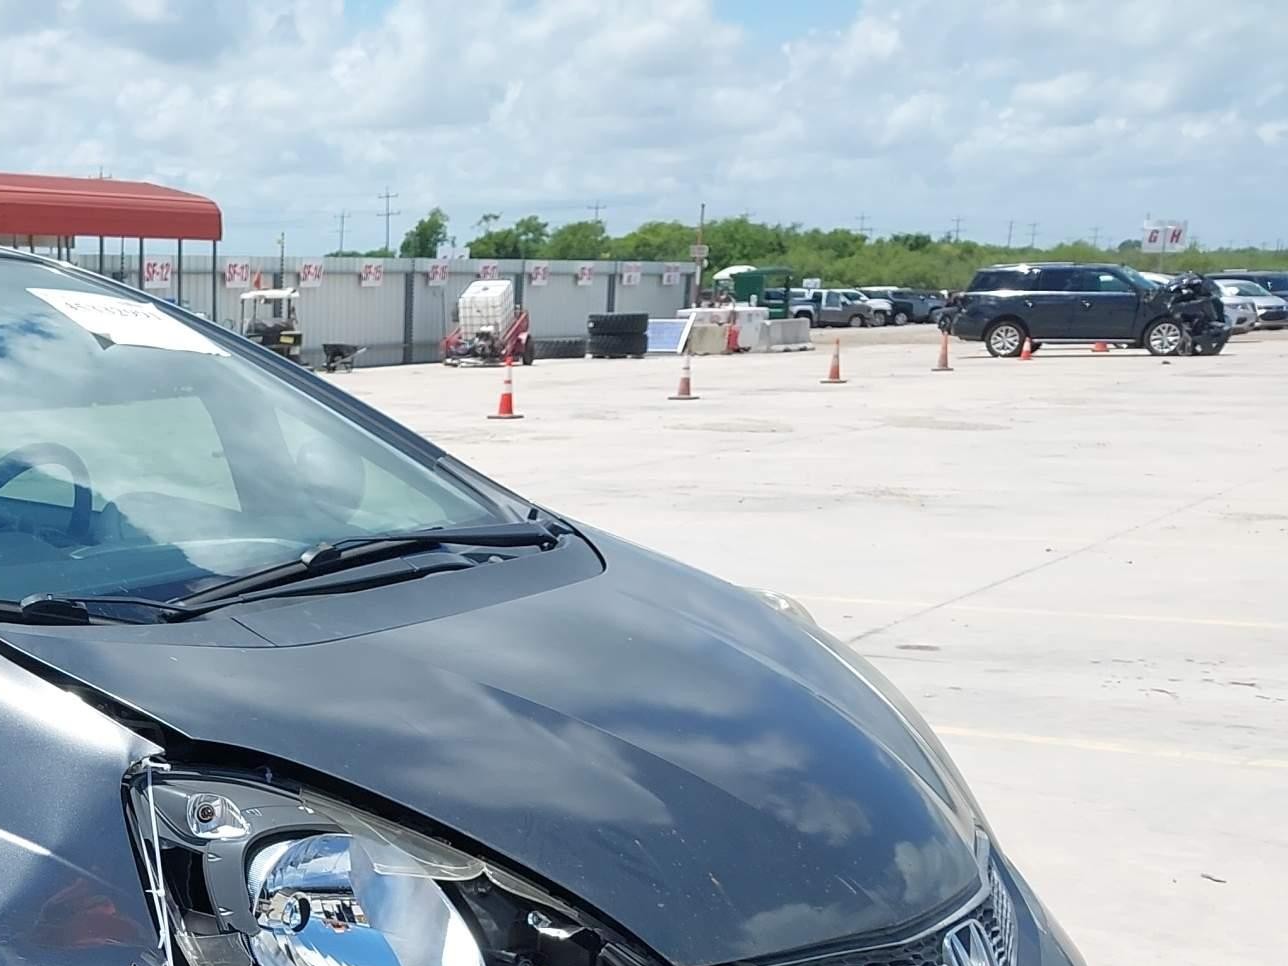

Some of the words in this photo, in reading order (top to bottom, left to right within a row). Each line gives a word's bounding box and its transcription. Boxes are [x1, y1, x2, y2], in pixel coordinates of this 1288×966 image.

[1148, 229, 1159, 243] G
[1170, 229, 1182, 243] H
[145, 261, 170, 282] SF-12
